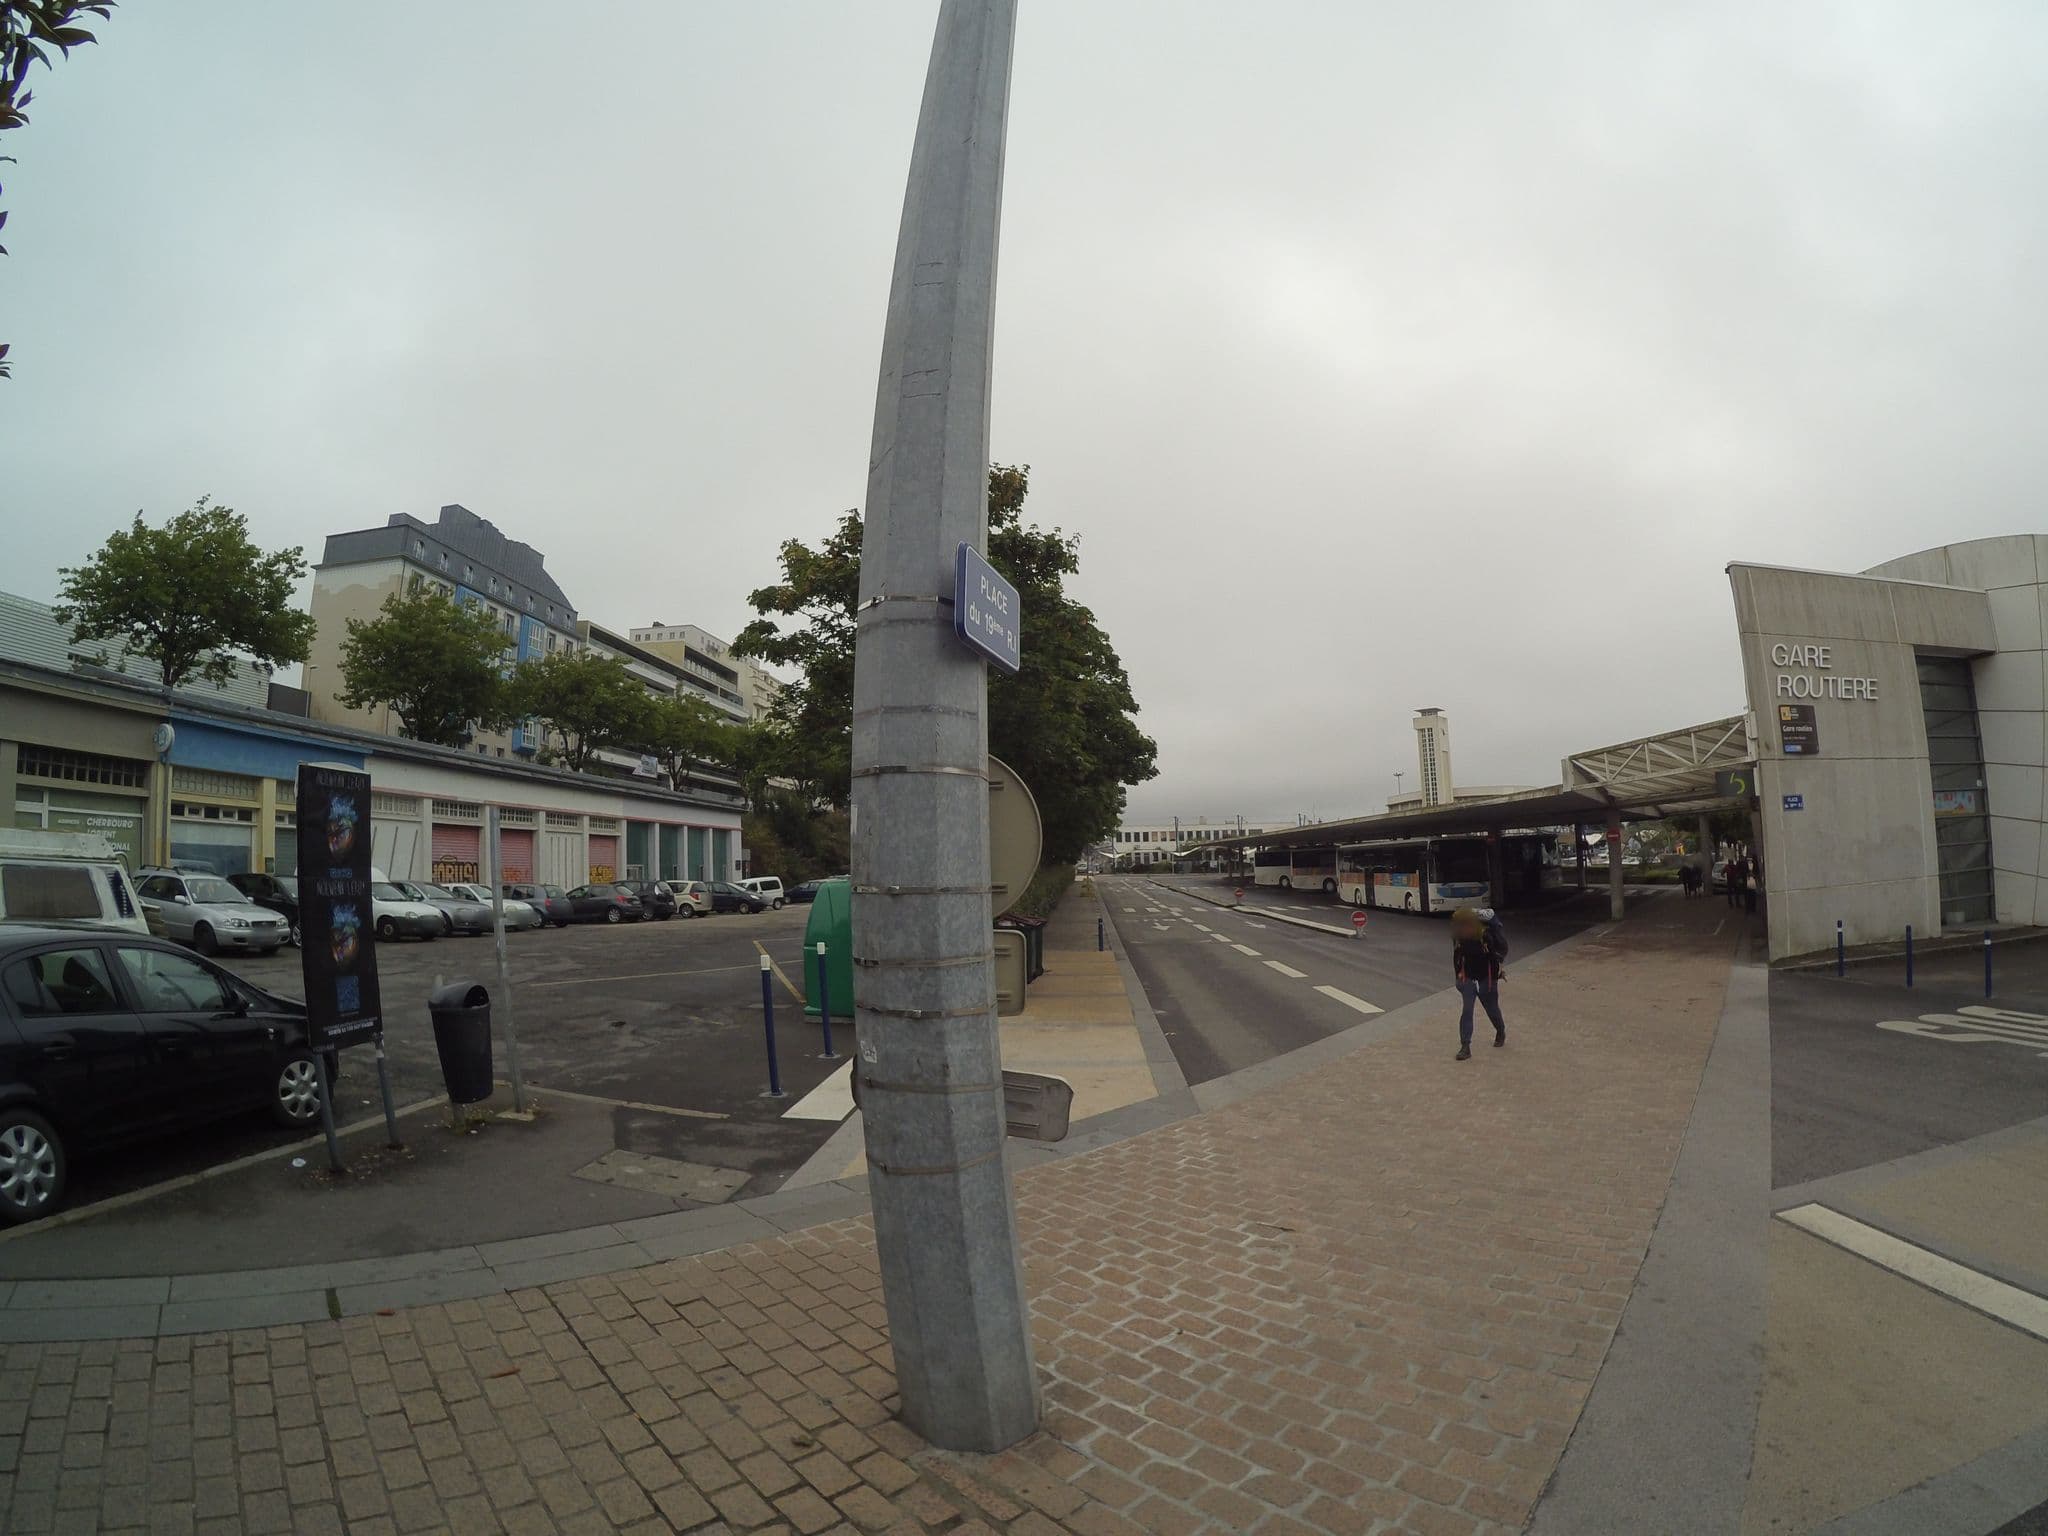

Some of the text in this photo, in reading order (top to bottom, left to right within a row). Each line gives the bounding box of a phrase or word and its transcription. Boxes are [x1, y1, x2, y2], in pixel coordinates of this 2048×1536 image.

[981, 575, 1008, 615] PLACE
[969, 601, 981, 625] du
[1771, 643, 1832, 669] GARE
[1777, 674, 1879, 700] ROUTIERE
[87, 817, 133, 829] CHERBOURG
